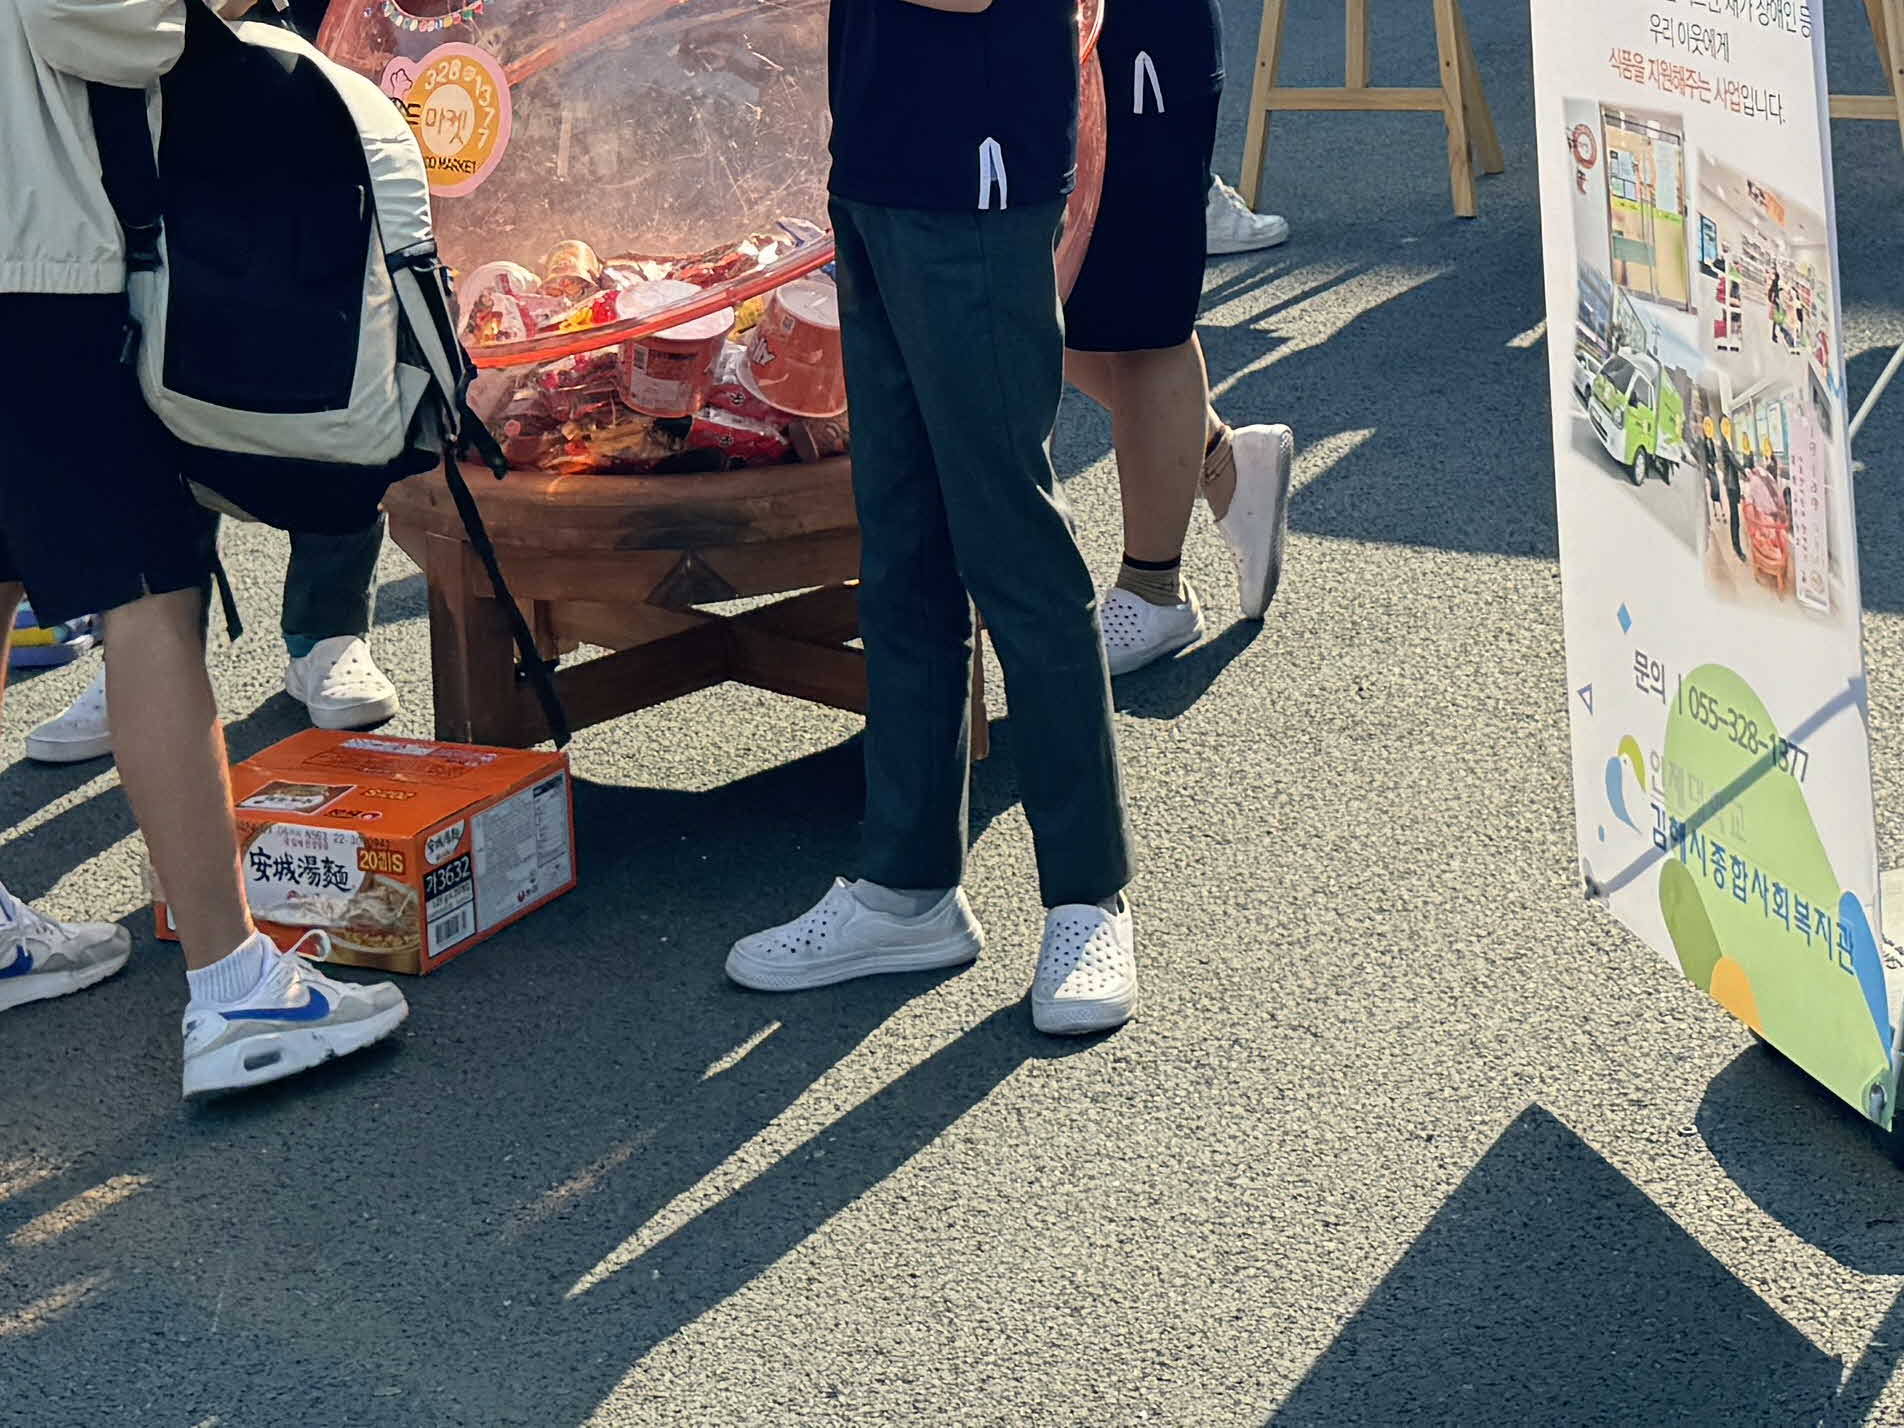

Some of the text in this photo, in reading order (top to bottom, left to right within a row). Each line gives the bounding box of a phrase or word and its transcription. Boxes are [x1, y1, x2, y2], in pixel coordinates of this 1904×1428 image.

[1648, 13, 1730, 64] 우리 이웃에게
[1608, 47, 1645, 85] 식품을
[1633, 649, 1668, 705] 문의
[1649, 802, 1857, 976] 김해시종합사회복지관
